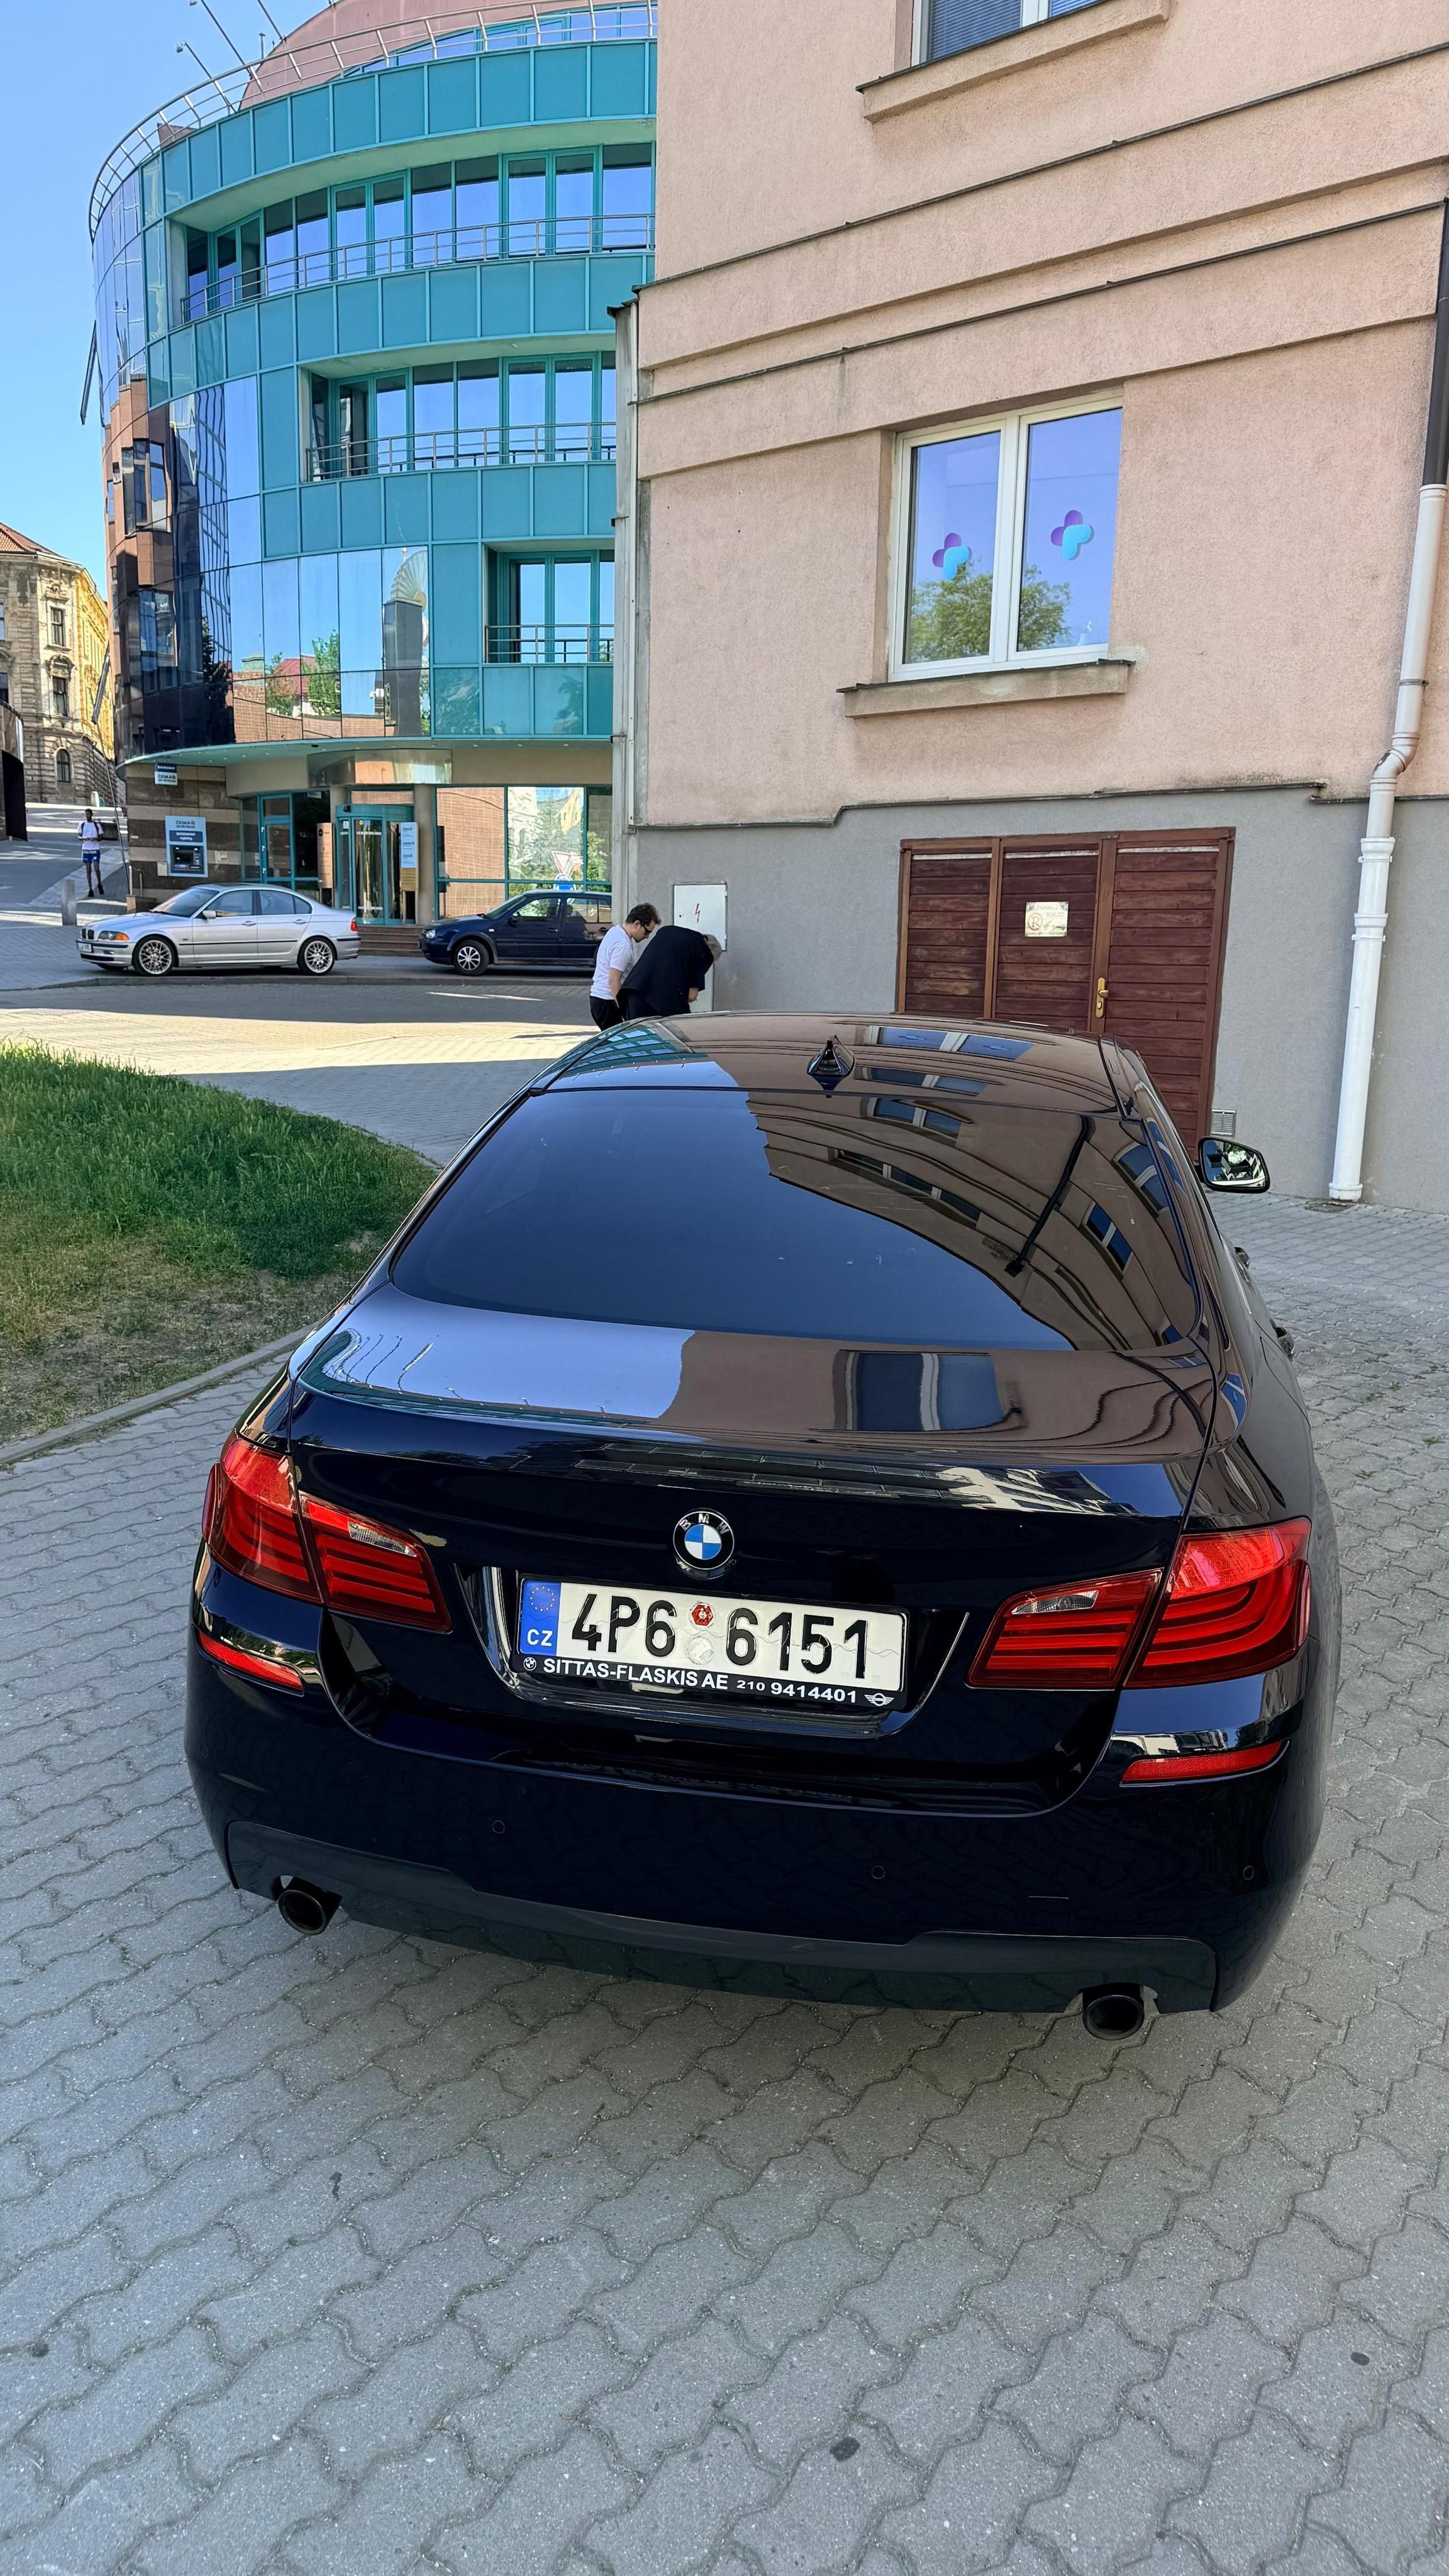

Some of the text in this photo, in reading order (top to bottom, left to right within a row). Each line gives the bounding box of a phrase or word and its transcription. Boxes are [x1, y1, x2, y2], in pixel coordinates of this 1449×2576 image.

[679, 1513, 730, 1535] BMW
[526, 1628, 553, 1647] CZ
[572, 1593, 868, 1679] 4P6 6151
[543, 1658, 856, 1703] SITTAS-FLASKIS AE 210 9414401
